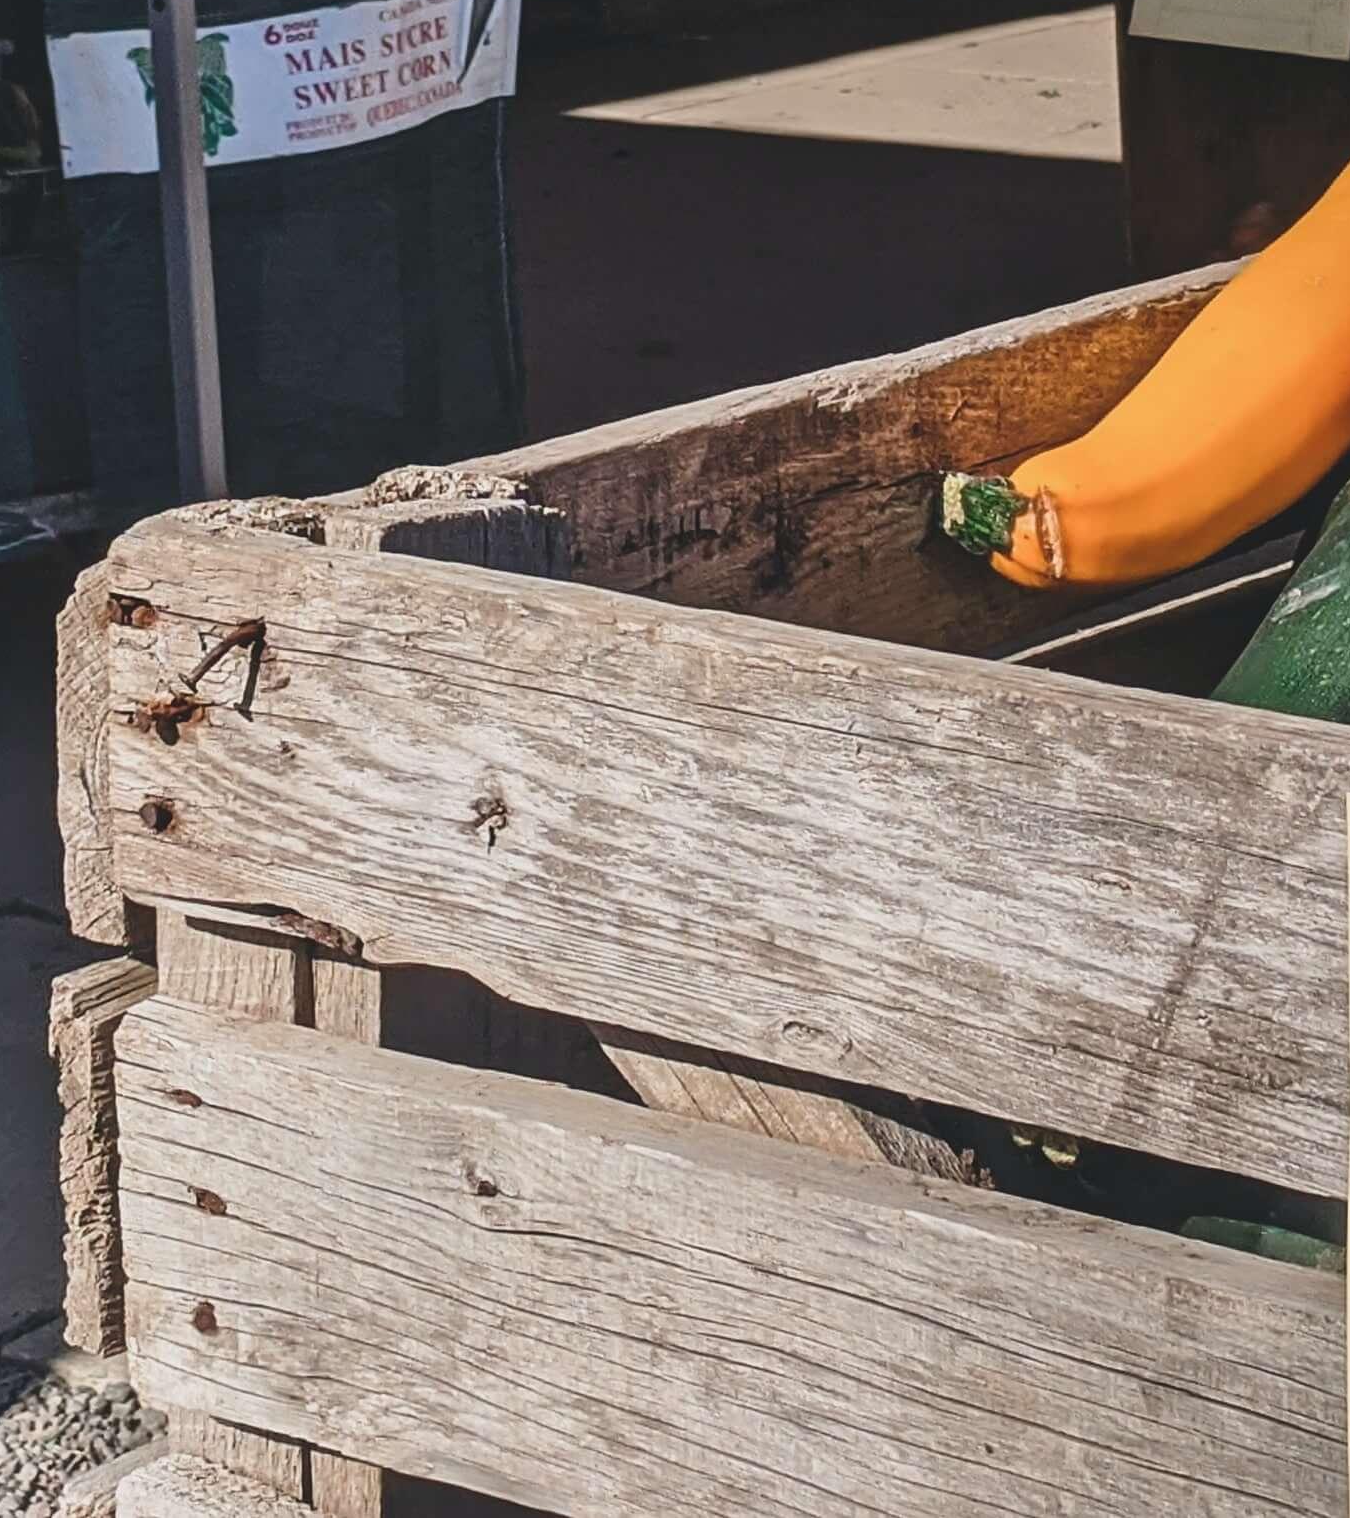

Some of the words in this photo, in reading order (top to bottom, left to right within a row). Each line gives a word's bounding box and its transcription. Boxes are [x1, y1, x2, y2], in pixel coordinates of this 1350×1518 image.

[264, 24, 281, 45] 6
[284, 39, 366, 75] MAIS
[294, 70, 389, 110] SWEET
[399, 48, 452, 86] CORN
